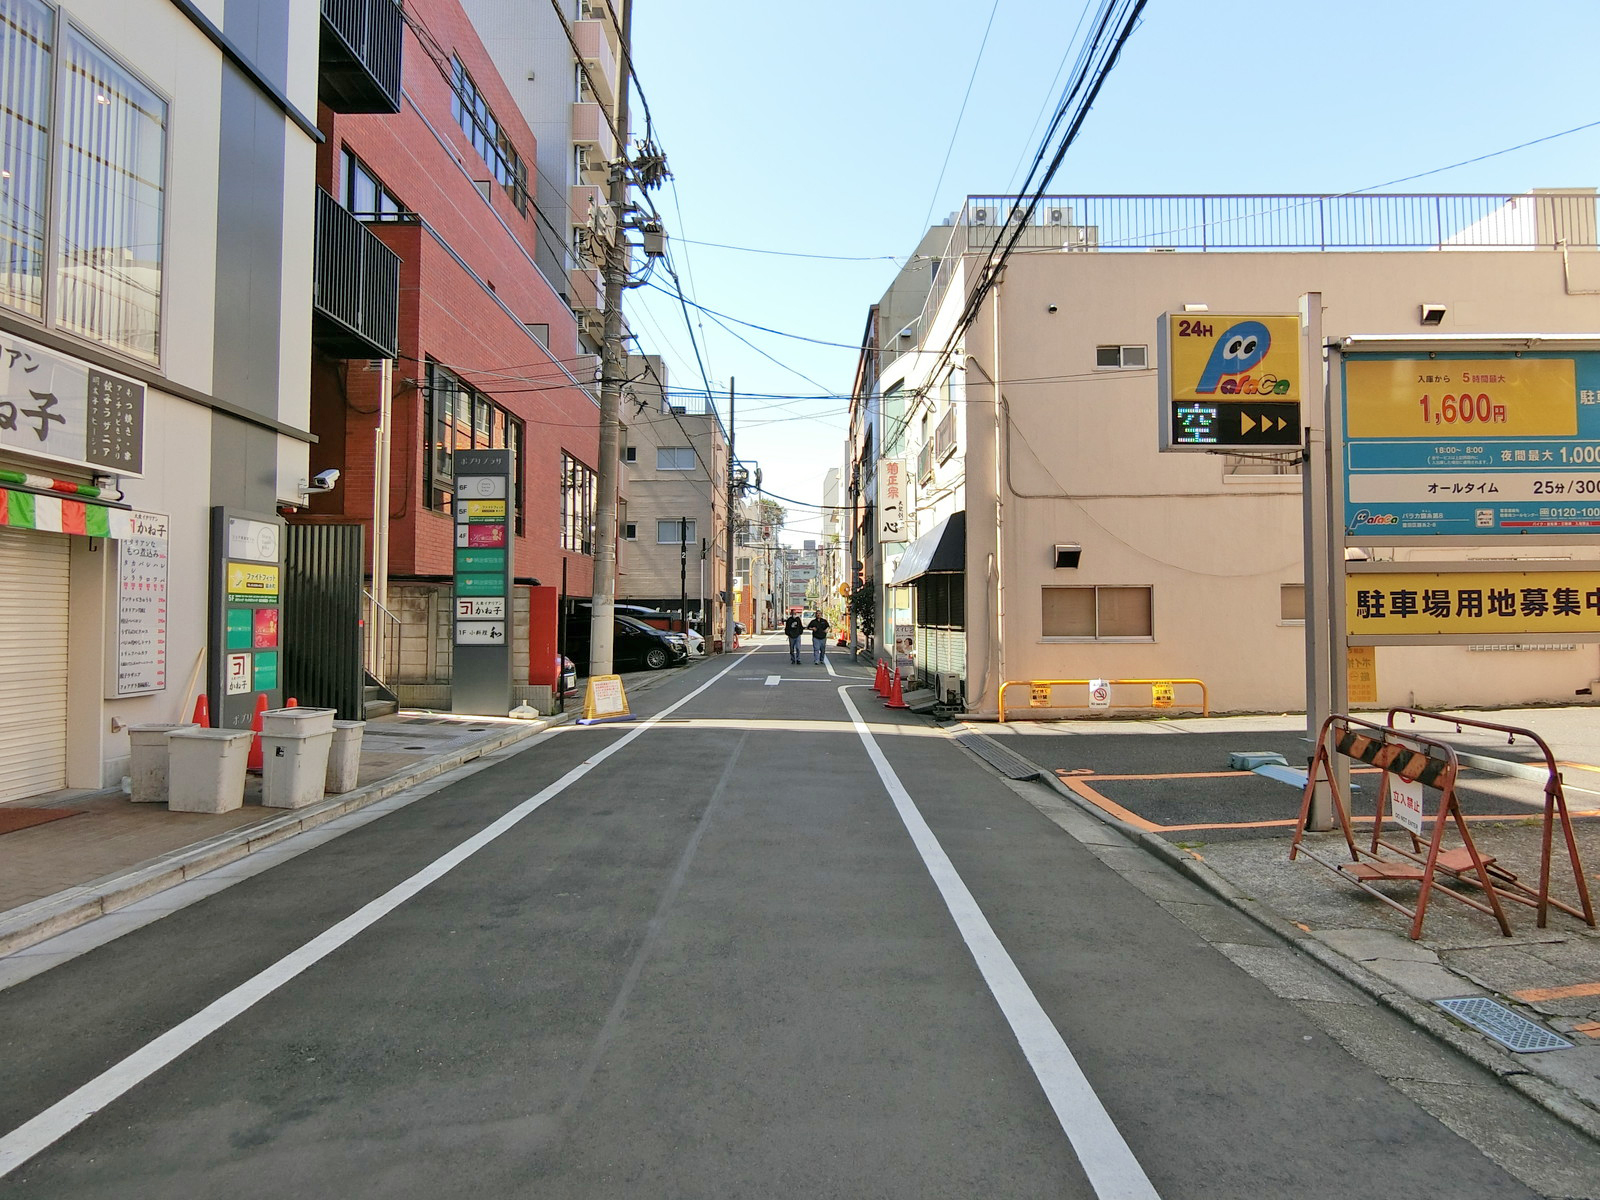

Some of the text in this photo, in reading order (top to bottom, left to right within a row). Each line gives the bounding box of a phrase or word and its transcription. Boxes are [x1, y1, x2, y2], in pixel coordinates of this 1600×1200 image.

[1179, 320, 1213, 338] 24H
[0, 344, 40, 374] アン
[1417, 375, 1451, 385] 入庫から
[102, 380, 113, 457] 餃子ラザニア
[1419, 393, 1507, 425] 1,600円
[1178, 403, 1217, 443] 空
[1466, 446, 1484, 454] 8:00
[1501, 450, 1554, 463] 夜間最大
[886, 462, 899, 500] 菊正宗
[1427, 482, 1500, 495] オールタイム
[137, 521, 167, 537] かね子
[883, 505, 899, 534] 一心
[475, 606, 503, 616] かね子
[1356, 587, 1600, 619] 駐車場用地募集中
[229, 680, 248, 691] かね子
[1393, 790, 1421, 813] 立入禁止
